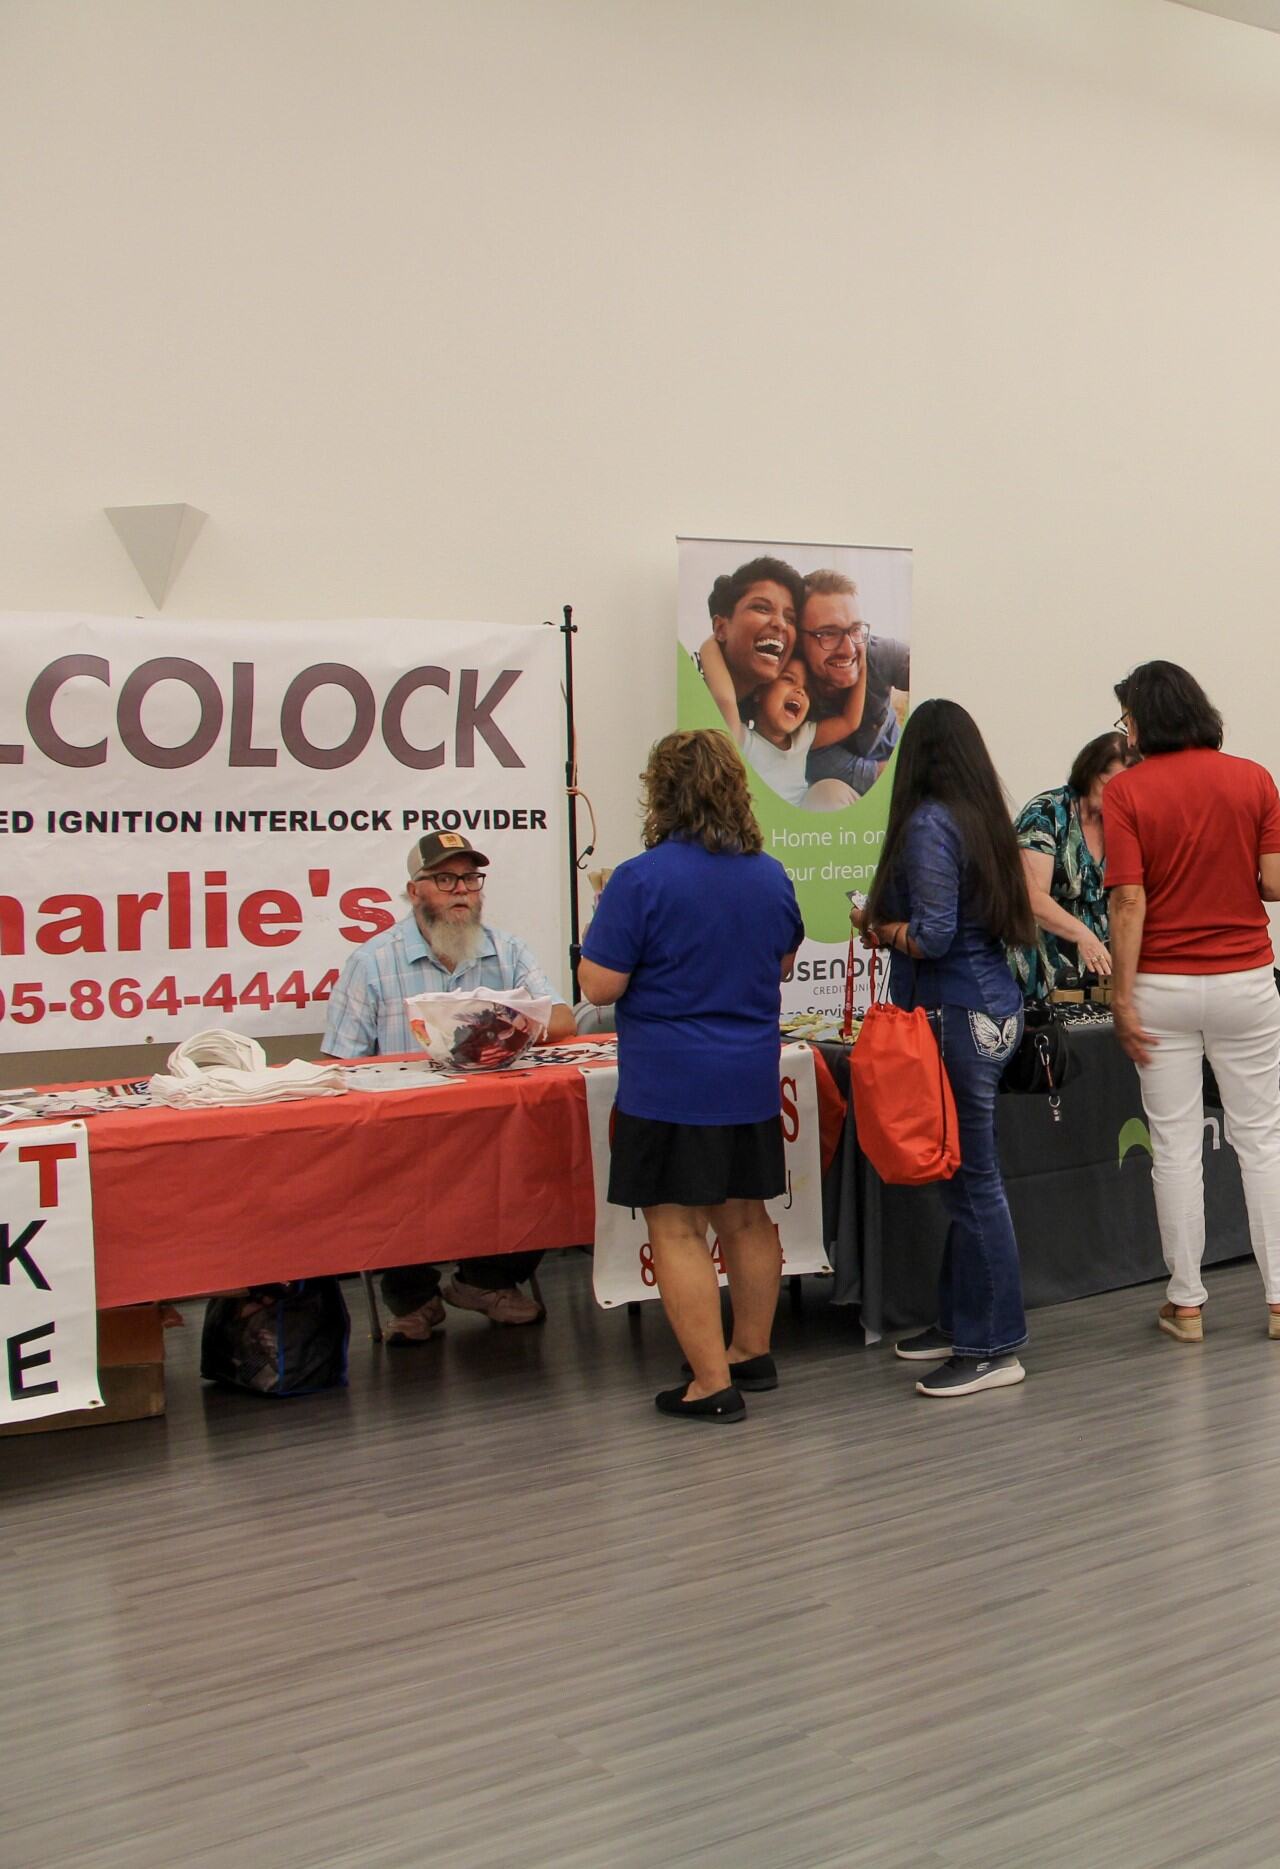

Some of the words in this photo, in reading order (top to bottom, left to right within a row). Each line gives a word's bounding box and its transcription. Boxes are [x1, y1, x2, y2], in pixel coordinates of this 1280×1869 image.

[47, 810, 202, 833] IGNITION
[214, 809, 392, 832] INTERLOCK
[403, 809, 547, 831] PROVIDER
[772, 828, 833, 847] Home
[840, 826, 857, 845] in
[786, 866, 816, 881] our
[0, 968, 341, 1025] 5-864-4444
[7, 1321, 59, 1400] E
